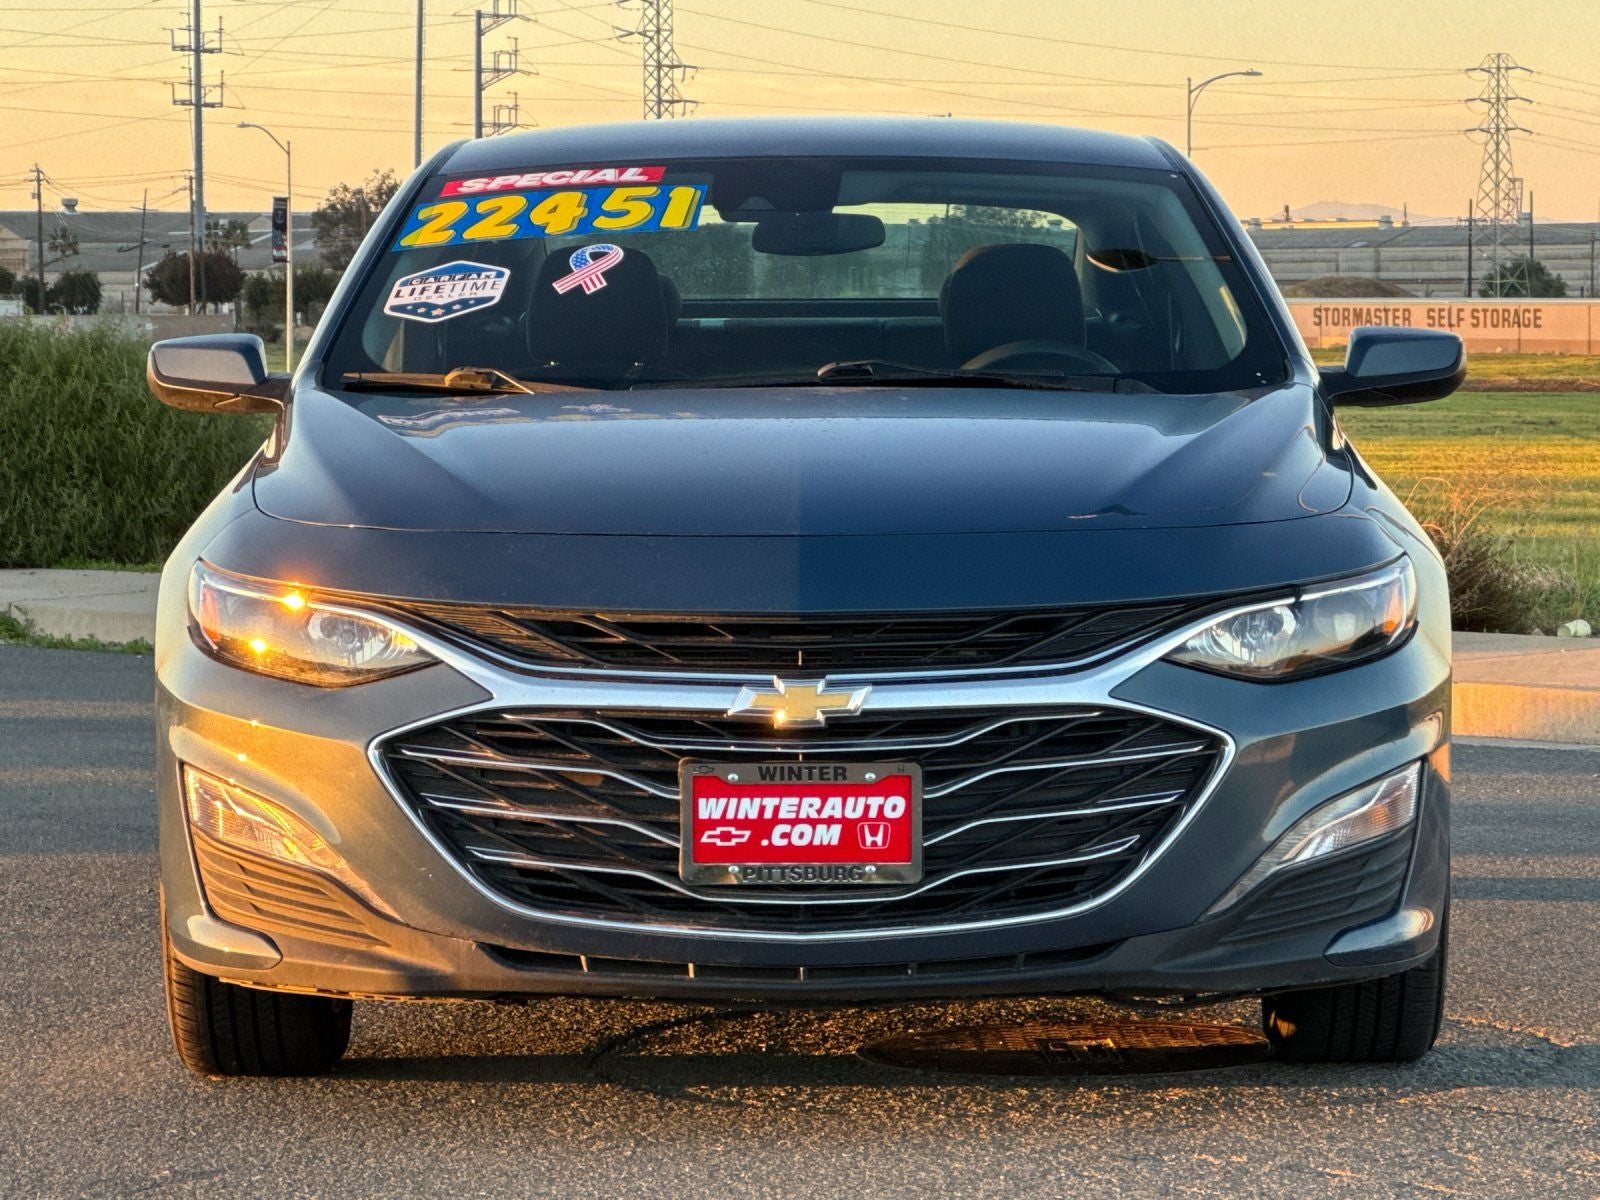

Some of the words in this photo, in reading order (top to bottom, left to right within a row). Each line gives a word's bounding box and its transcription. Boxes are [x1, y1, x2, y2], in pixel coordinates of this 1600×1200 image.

[457, 168, 649, 193] SPECIAL
[399, 187, 700, 247] 22451
[408, 271, 497, 286] CARFAX
[394, 280, 501, 298] LIFETIME
[414, 292, 477, 301] DEALER
[1313, 307, 1411, 327] STORMASTER
[1426, 308, 1465, 328] SELF
[1471, 308, 1542, 328] STORAGE
[758, 765, 848, 782] WINTER
[698, 796, 906, 820] WINTERAUTO
[760, 823, 842, 847] .COM
[742, 865, 864, 883] PITTSBURG
